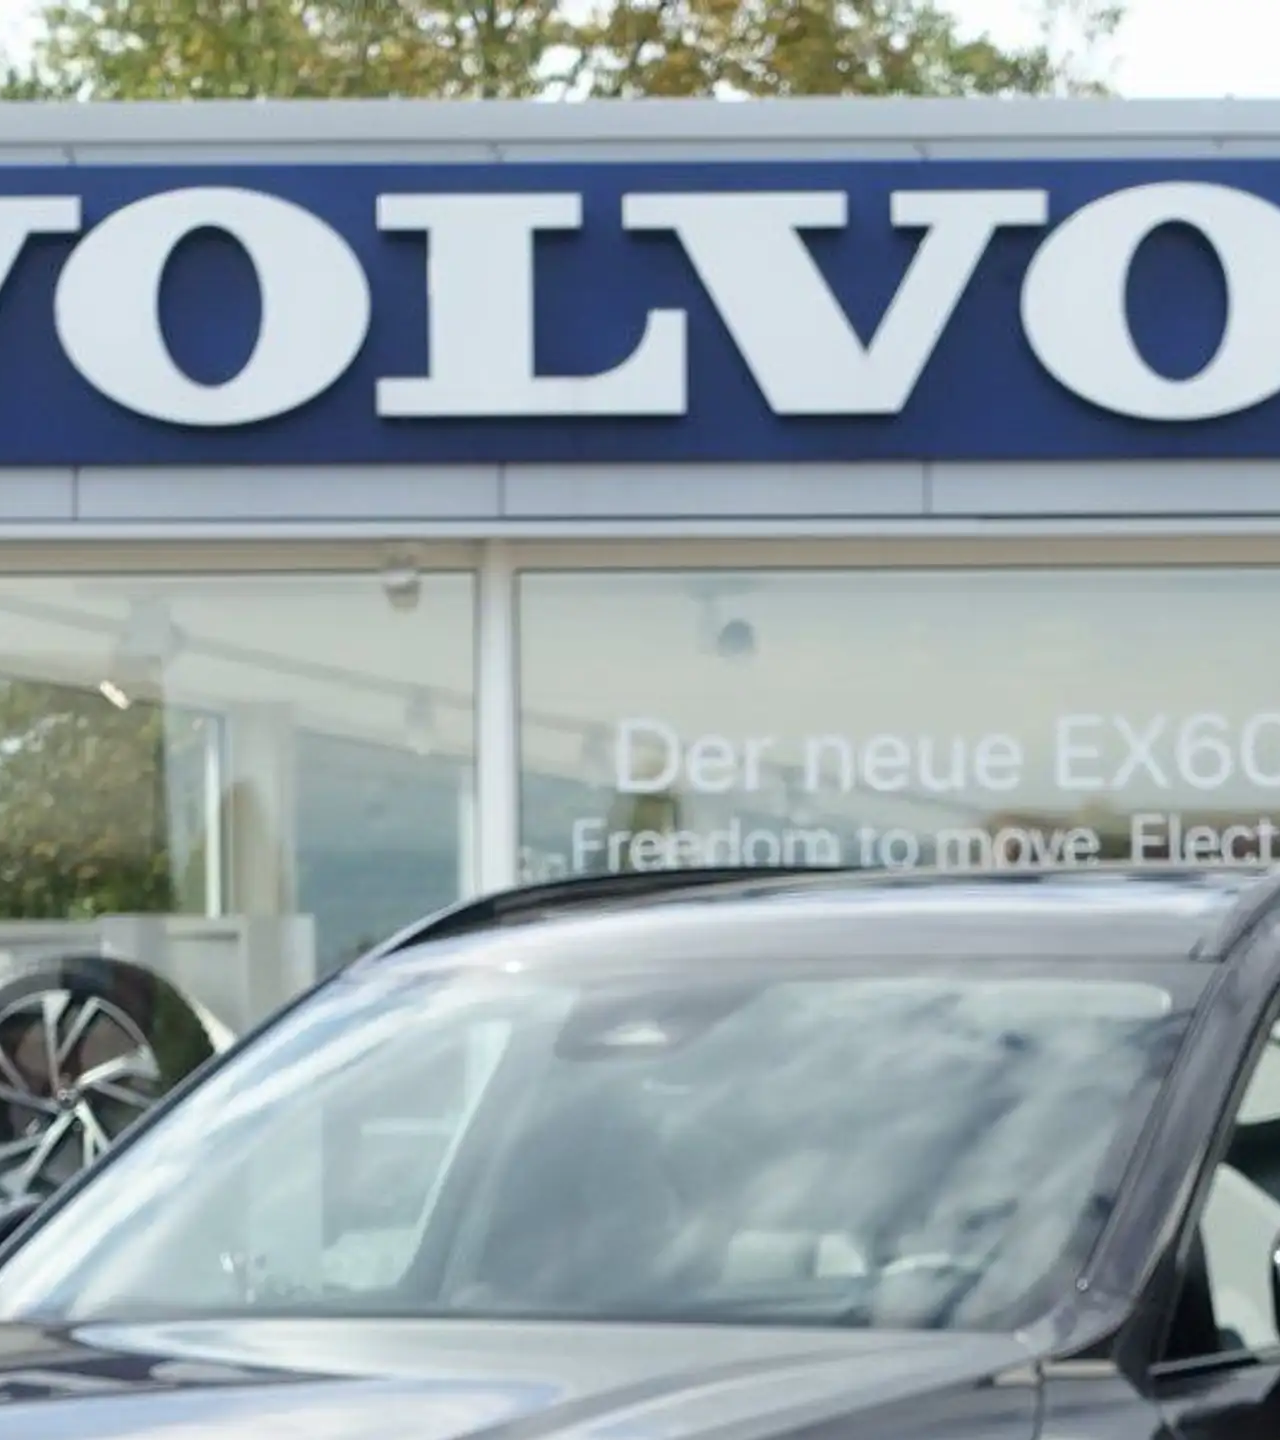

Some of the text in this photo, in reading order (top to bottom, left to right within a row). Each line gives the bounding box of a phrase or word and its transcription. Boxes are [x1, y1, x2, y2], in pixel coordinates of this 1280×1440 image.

[616, 716, 775, 795] Der
[803, 728, 1023, 793] neue
[572, 817, 841, 872] Freedom
[856, 826, 920, 869] to
